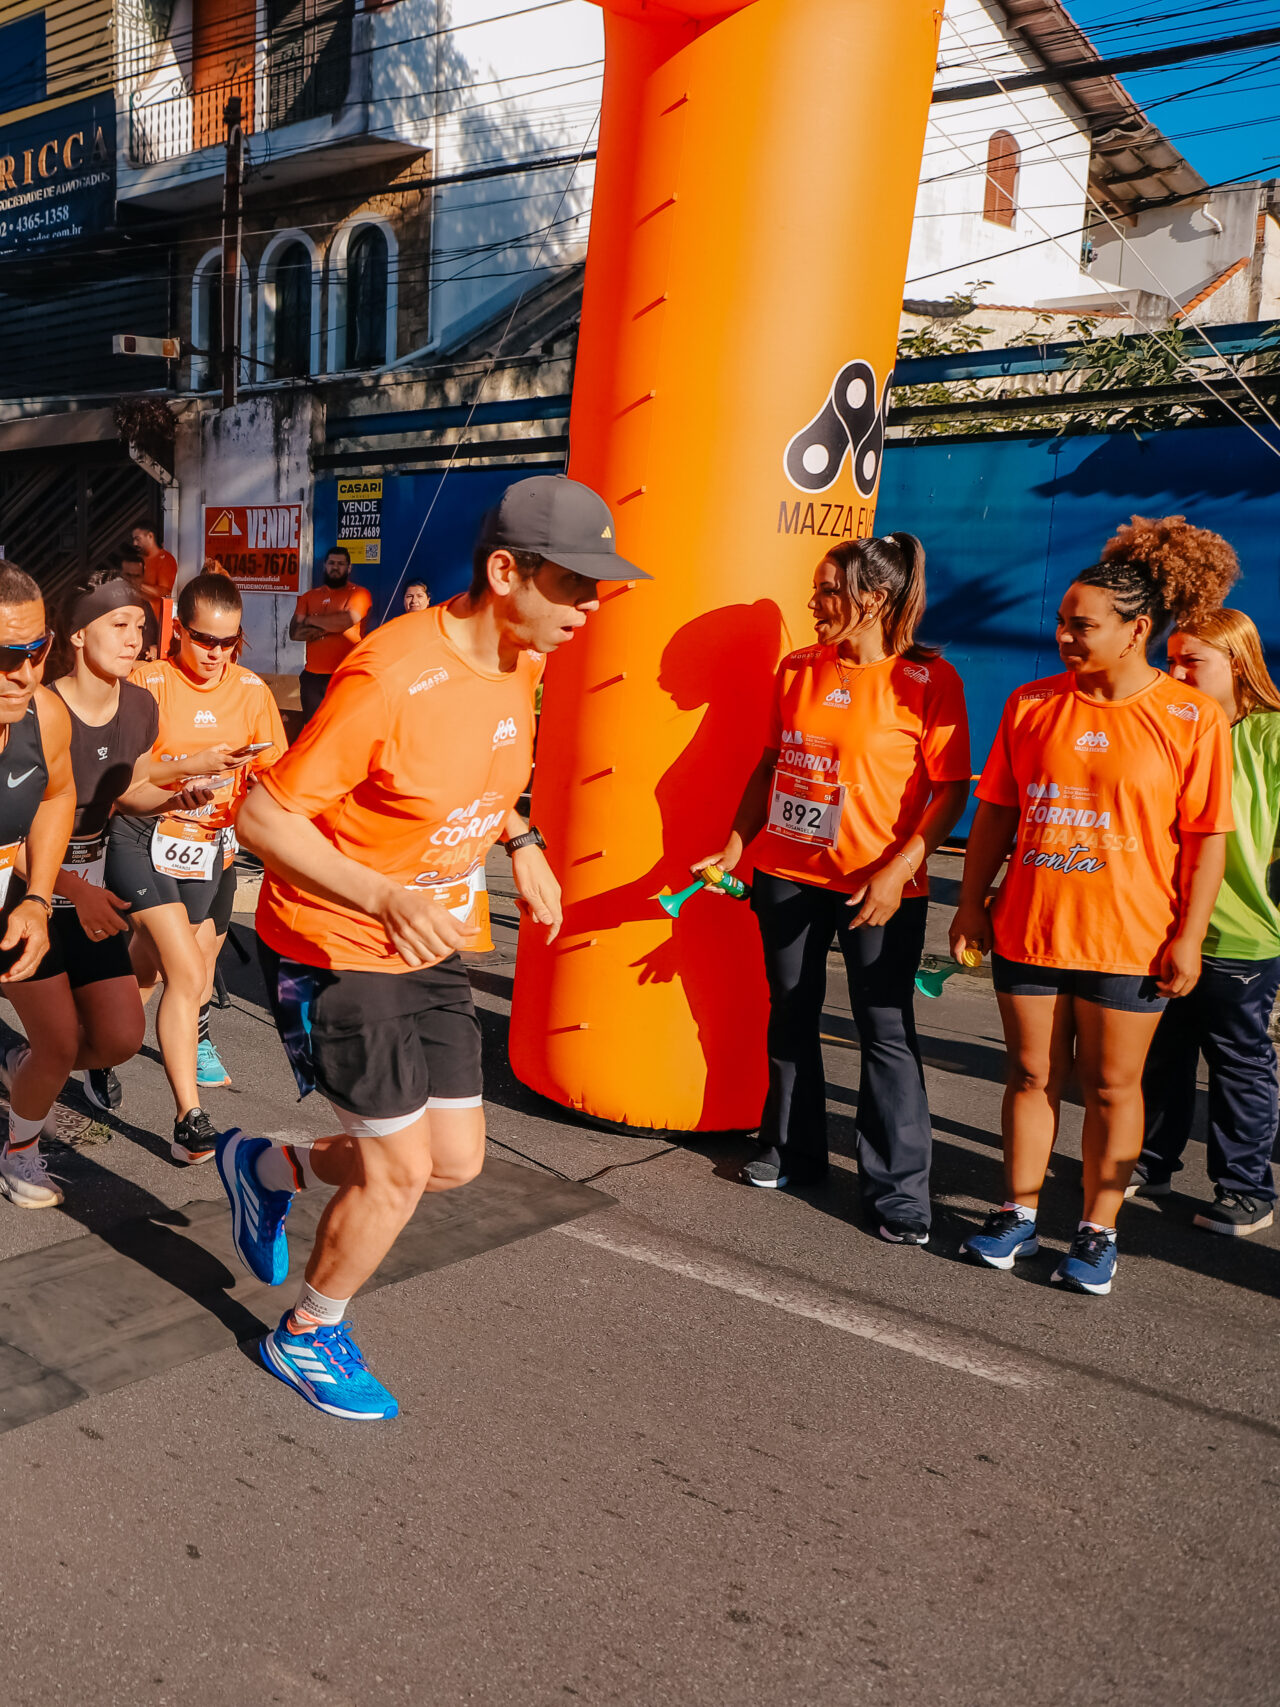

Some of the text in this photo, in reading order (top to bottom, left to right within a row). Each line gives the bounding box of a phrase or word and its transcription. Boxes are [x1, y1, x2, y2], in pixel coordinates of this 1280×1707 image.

[16, 204, 70, 233] 4365-1358
[339, 482, 382, 494] CASARI
[341, 513, 381, 526] 4122.7777
[342, 501, 378, 513] VENDE
[777, 501, 852, 538] MAZZA
[246, 507, 300, 549] VENDE
[408, 669, 449, 696] MORASSI
[824, 794, 835, 802] 5K
[782, 800, 822, 830] 892
[1026, 806, 1111, 830] CORRIDA
[1022, 826, 1139, 853] CADA PASSO
[165, 842, 204, 866] 662
[1023, 843, 1107, 874] conta
